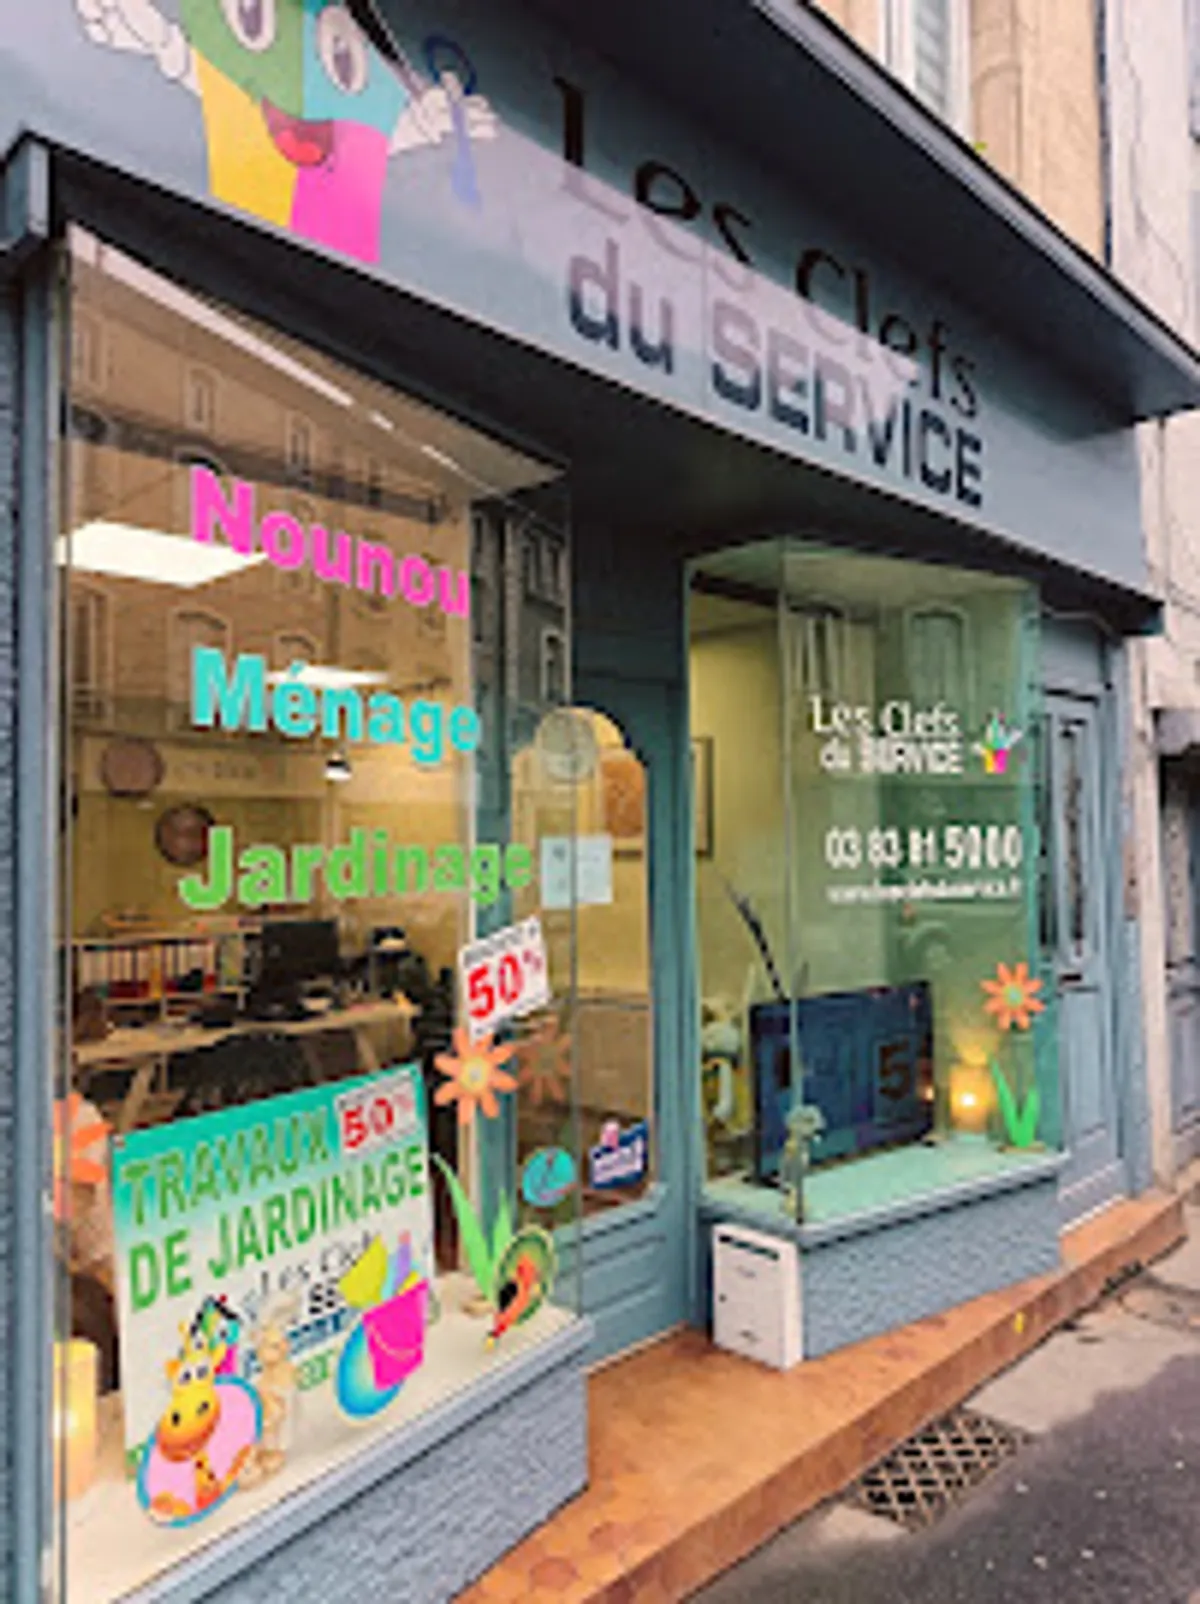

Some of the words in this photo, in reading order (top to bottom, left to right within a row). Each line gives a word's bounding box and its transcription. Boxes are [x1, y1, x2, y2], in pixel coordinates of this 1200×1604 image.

[552, 75, 757, 294] Les
[796, 247, 977, 420] Clefs
[568, 237, 675, 375] du
[711, 297, 983, 509] SERVICE
[189, 466, 471, 619] Nounou
[191, 646, 481, 765] Ménage
[810, 694, 874, 737] Les
[178, 826, 533, 911] Jardinage
[122, 1107, 329, 1225] TRAVAUX
[129, 1229, 192, 1312] DE
[207, 1145, 424, 1279] JARDINAGE
